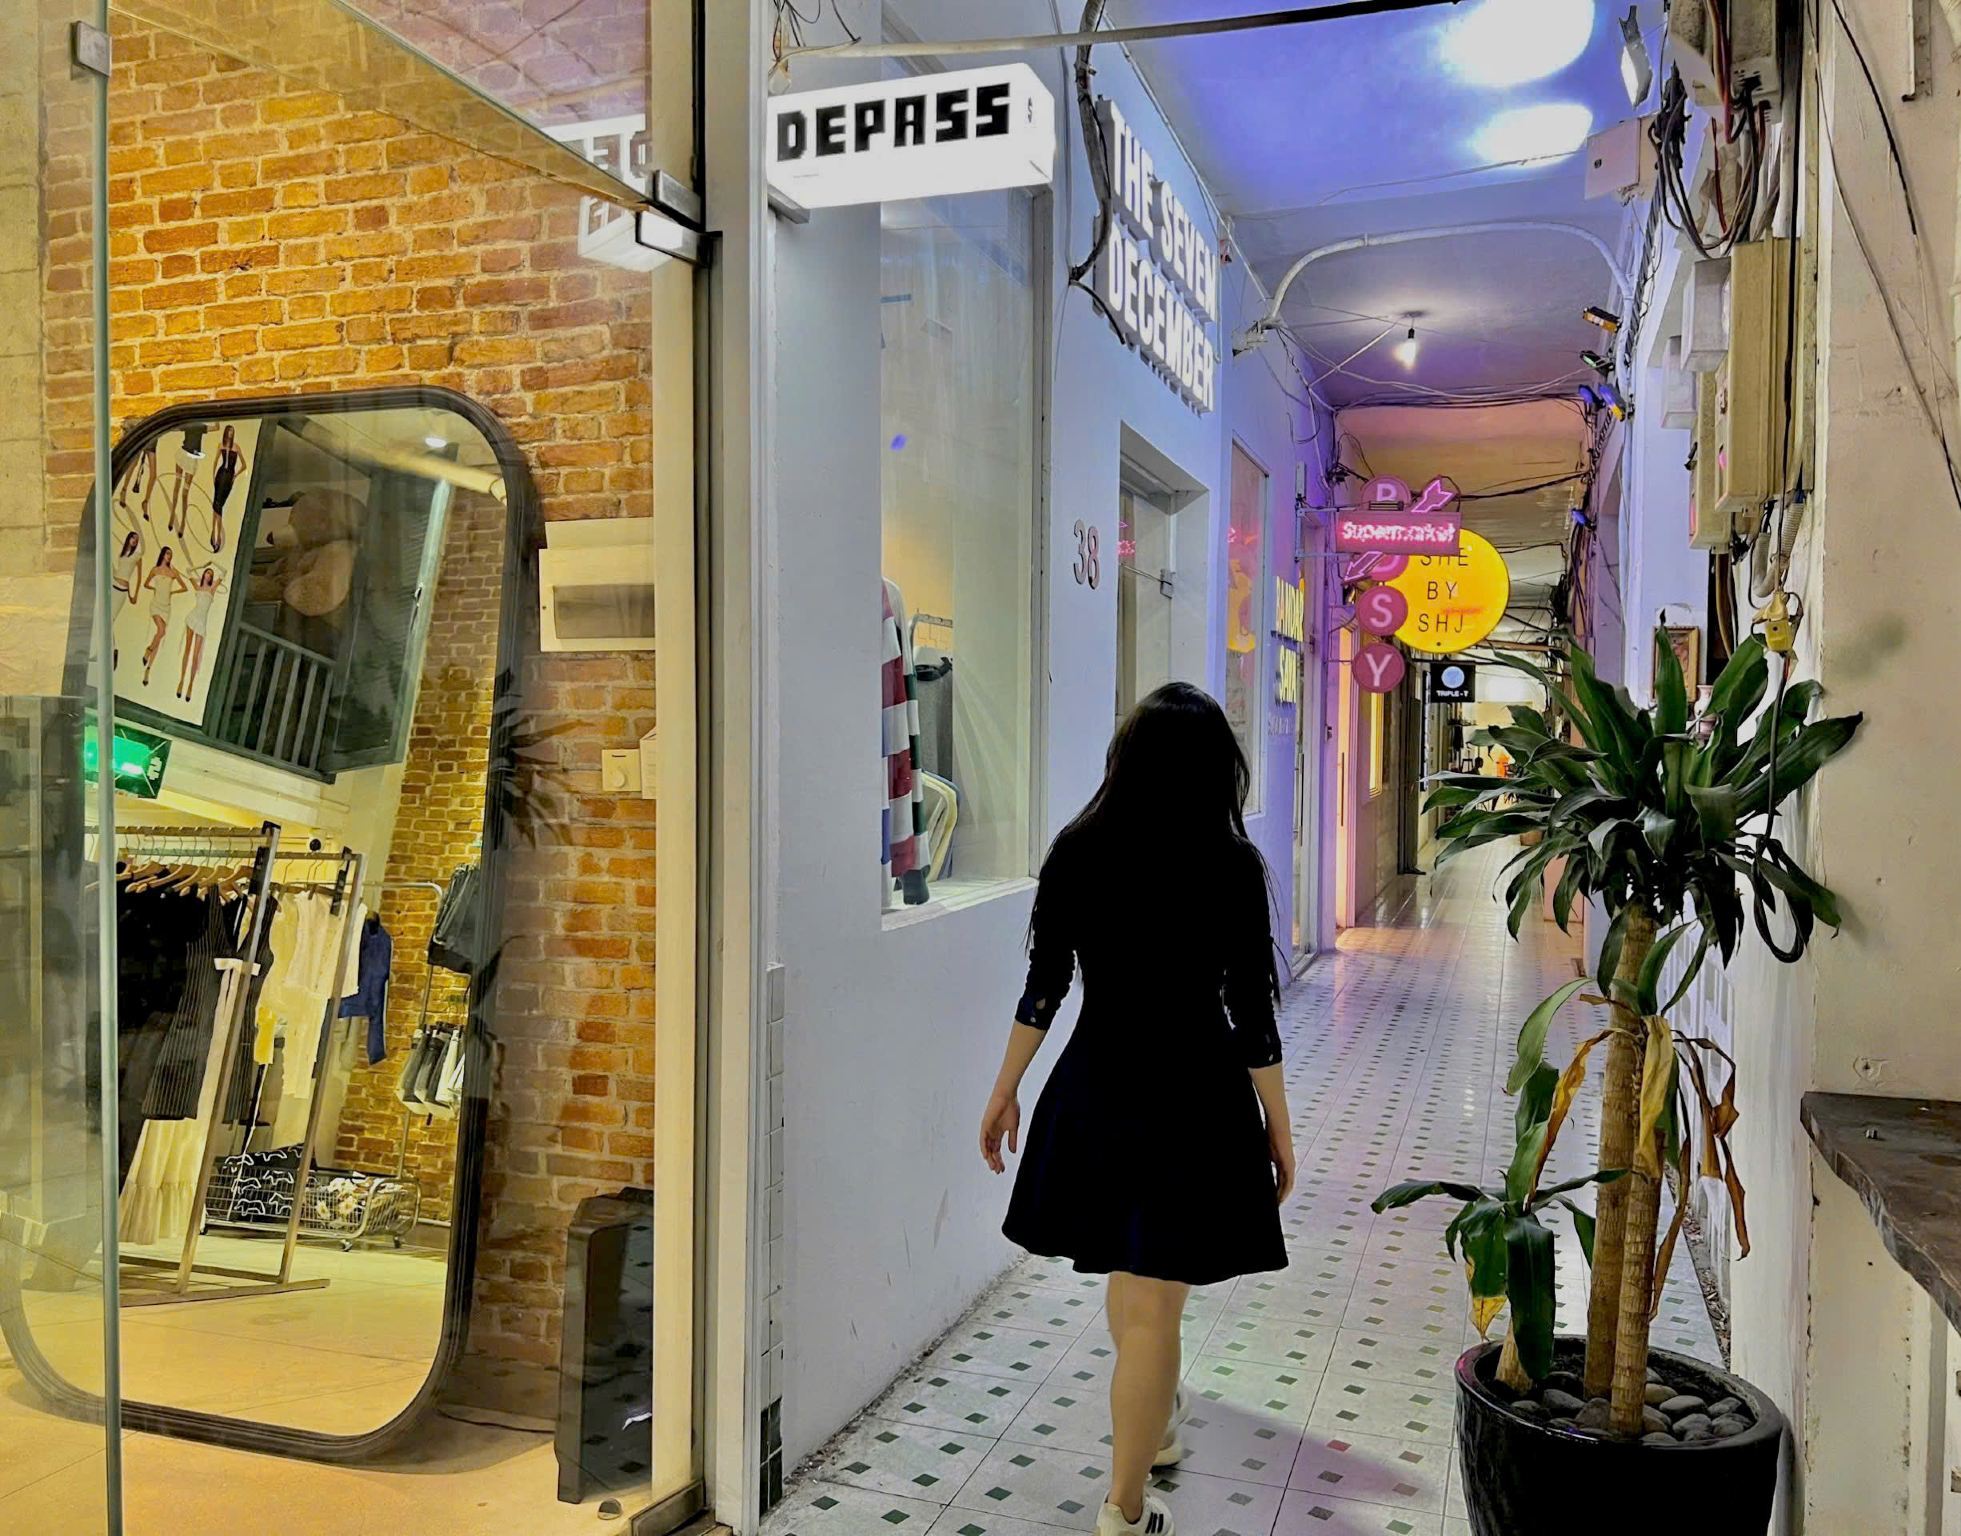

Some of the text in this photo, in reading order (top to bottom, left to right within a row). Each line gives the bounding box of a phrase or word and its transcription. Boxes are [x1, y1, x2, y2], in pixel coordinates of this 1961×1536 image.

[778, 82, 1010, 162] DEPASS
[1110, 100, 1218, 323] THE SEVEN
[1107, 218, 1215, 414] DECEMBER
[1073, 519, 1100, 590] 38
[1428, 580, 1457, 601] BY
